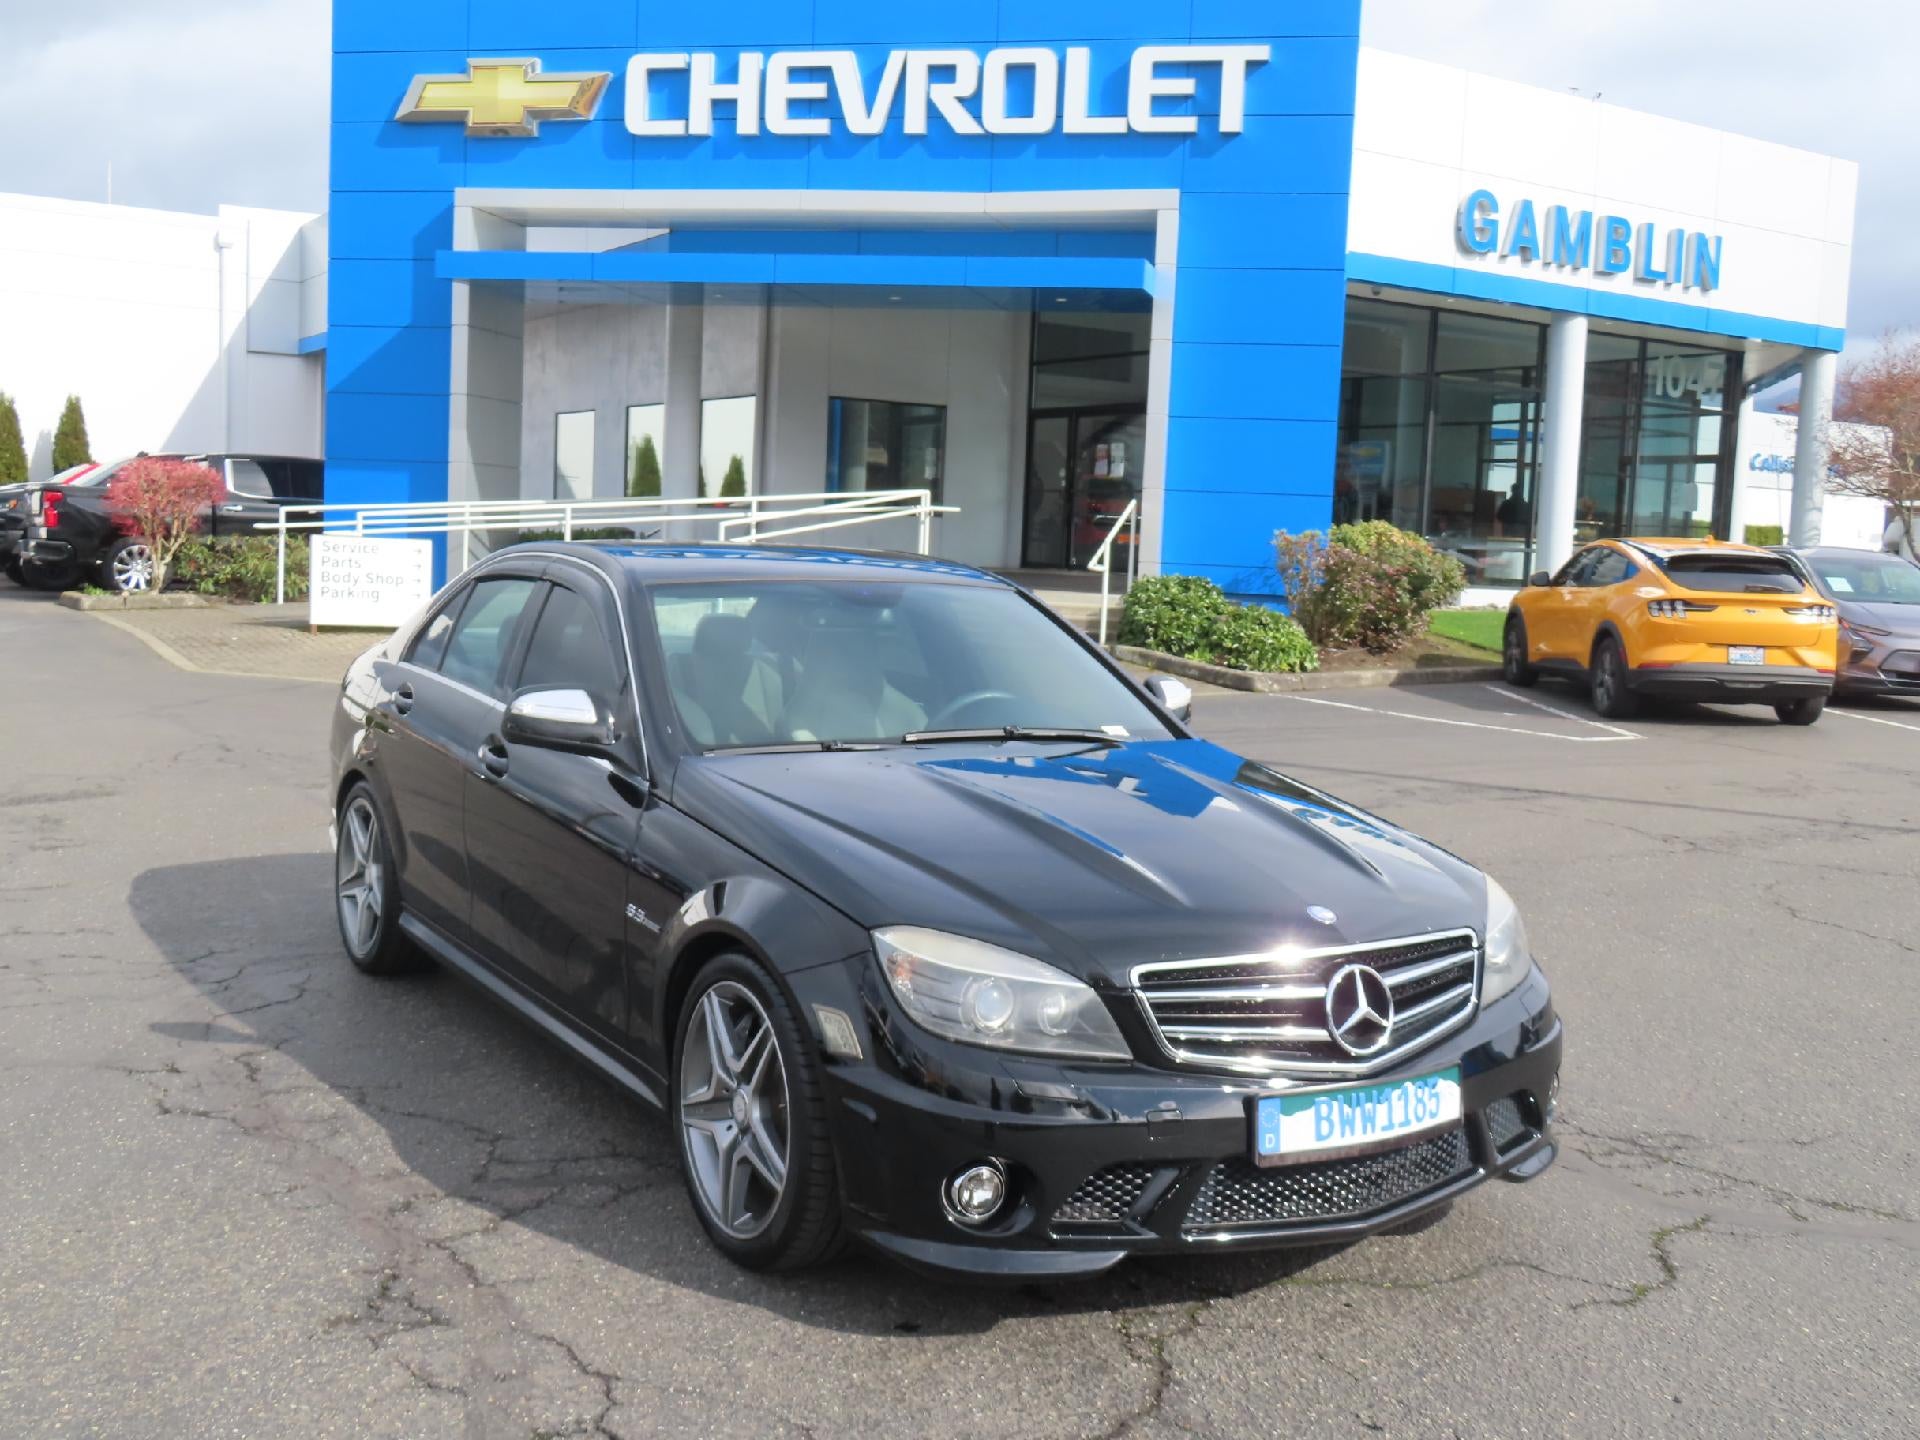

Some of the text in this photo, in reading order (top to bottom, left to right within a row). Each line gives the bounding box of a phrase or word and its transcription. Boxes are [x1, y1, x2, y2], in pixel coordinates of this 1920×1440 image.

[624, 44, 1271, 137] CHEVROLET
[1456, 188, 1723, 292] GAMBLIN
[322, 540, 379, 554] Service
[321, 556, 361, 569] Parts
[321, 571, 404, 587] Body Shop
[320, 586, 380, 602] Parking
[1265, 1133, 1276, 1148] D
